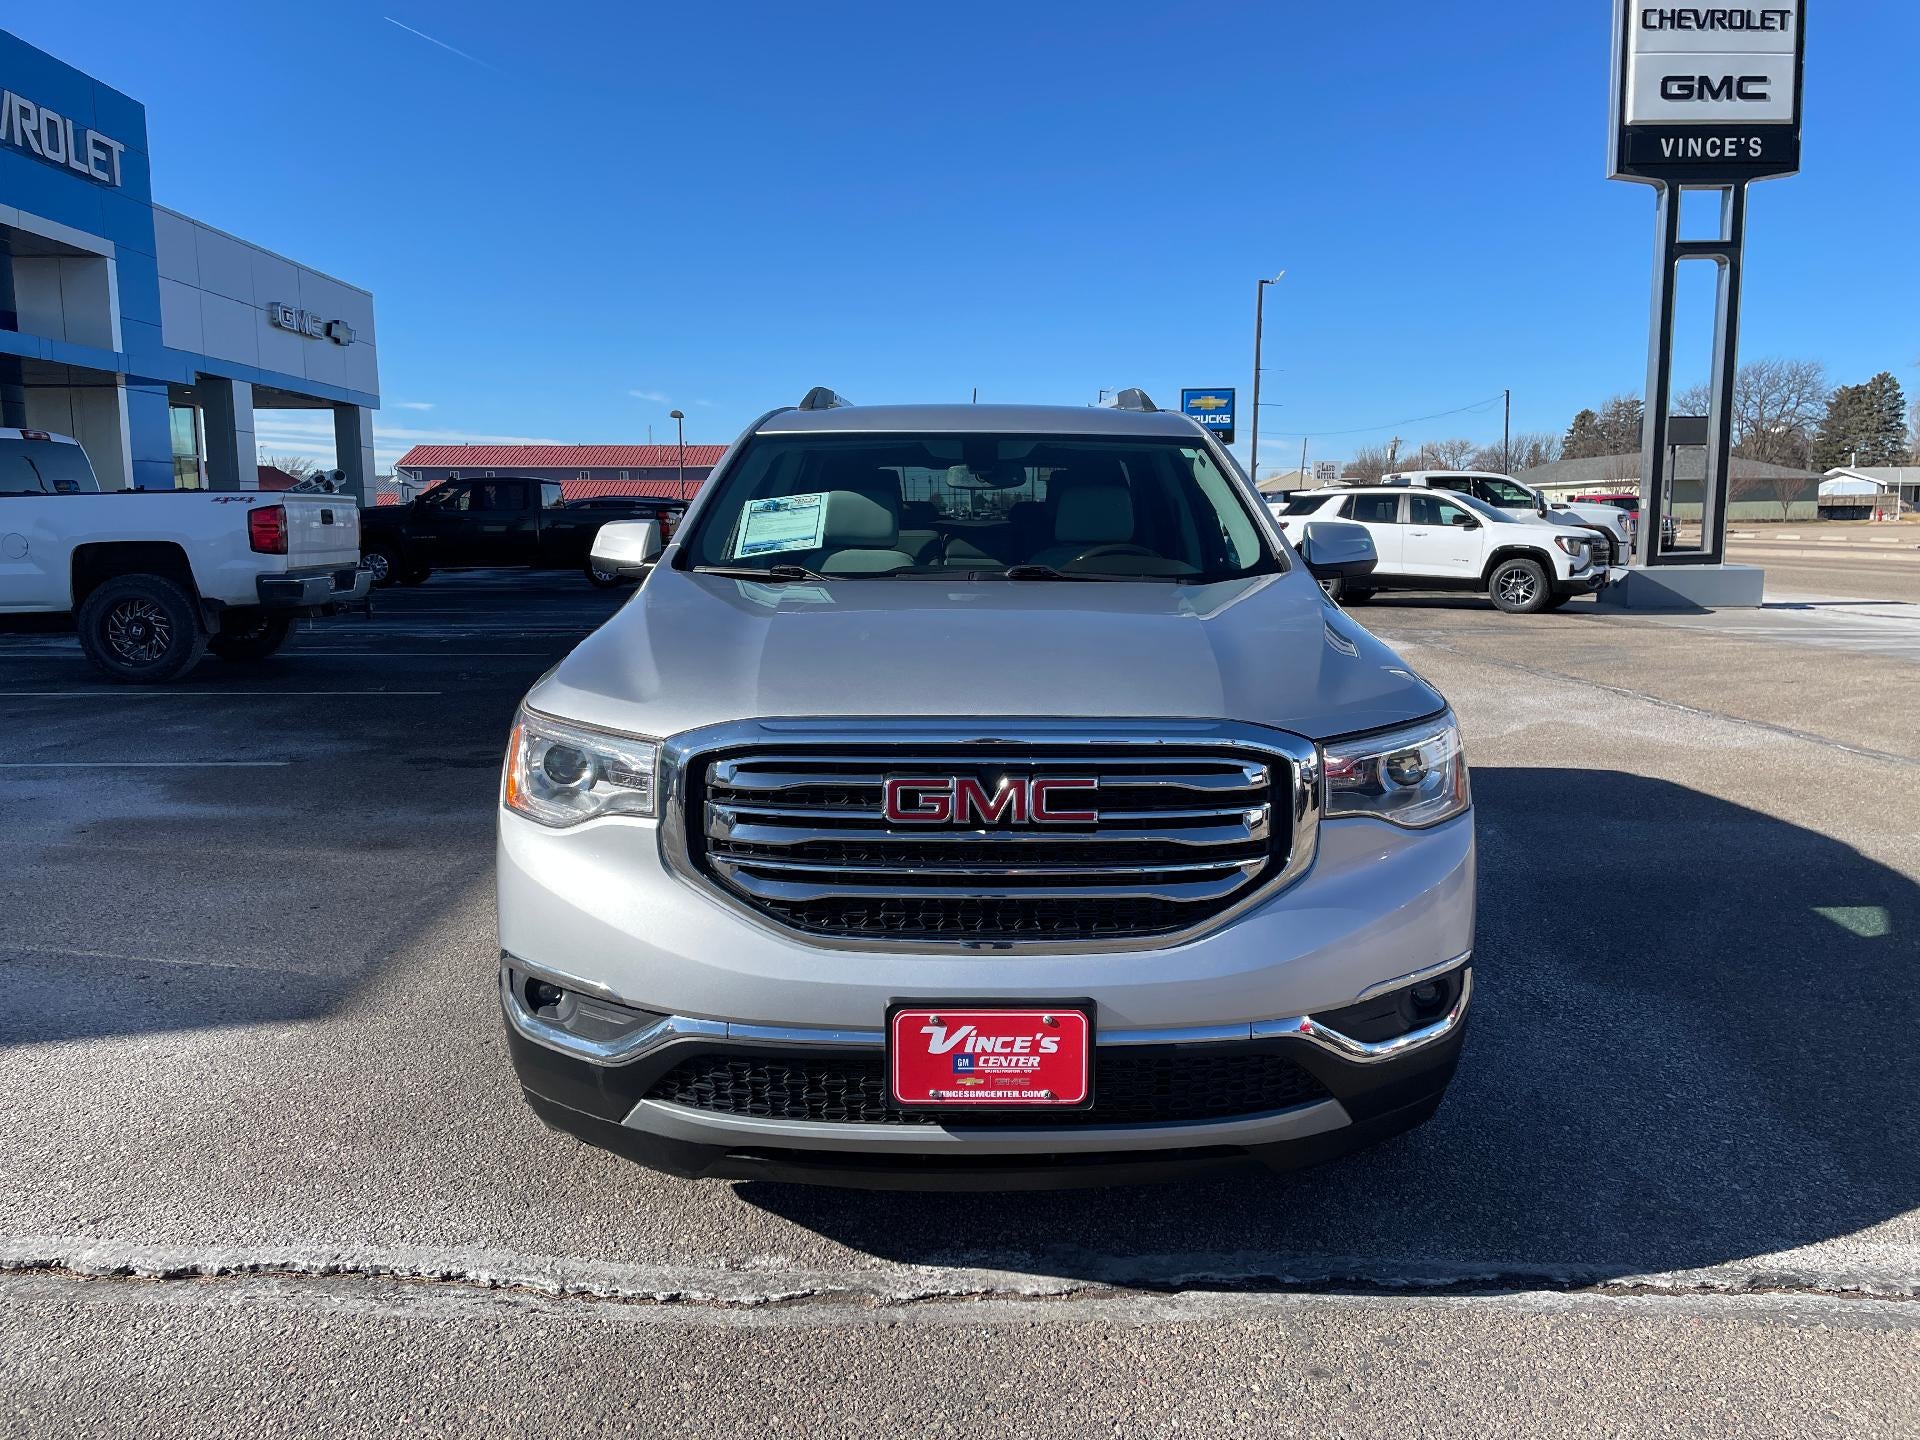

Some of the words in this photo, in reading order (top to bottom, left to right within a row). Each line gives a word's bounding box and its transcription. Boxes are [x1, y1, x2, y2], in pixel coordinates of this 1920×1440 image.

[1641, 8, 1791, 31] CHEVROLET
[1660, 75, 1768, 101] GMC
[1660, 136, 1763, 158] VINCE'S
[277, 302, 324, 340] GMC
[882, 776, 1099, 824] GMC
[957, 1058, 969, 1067] GM
[978, 1056, 1041, 1067] CENTER
